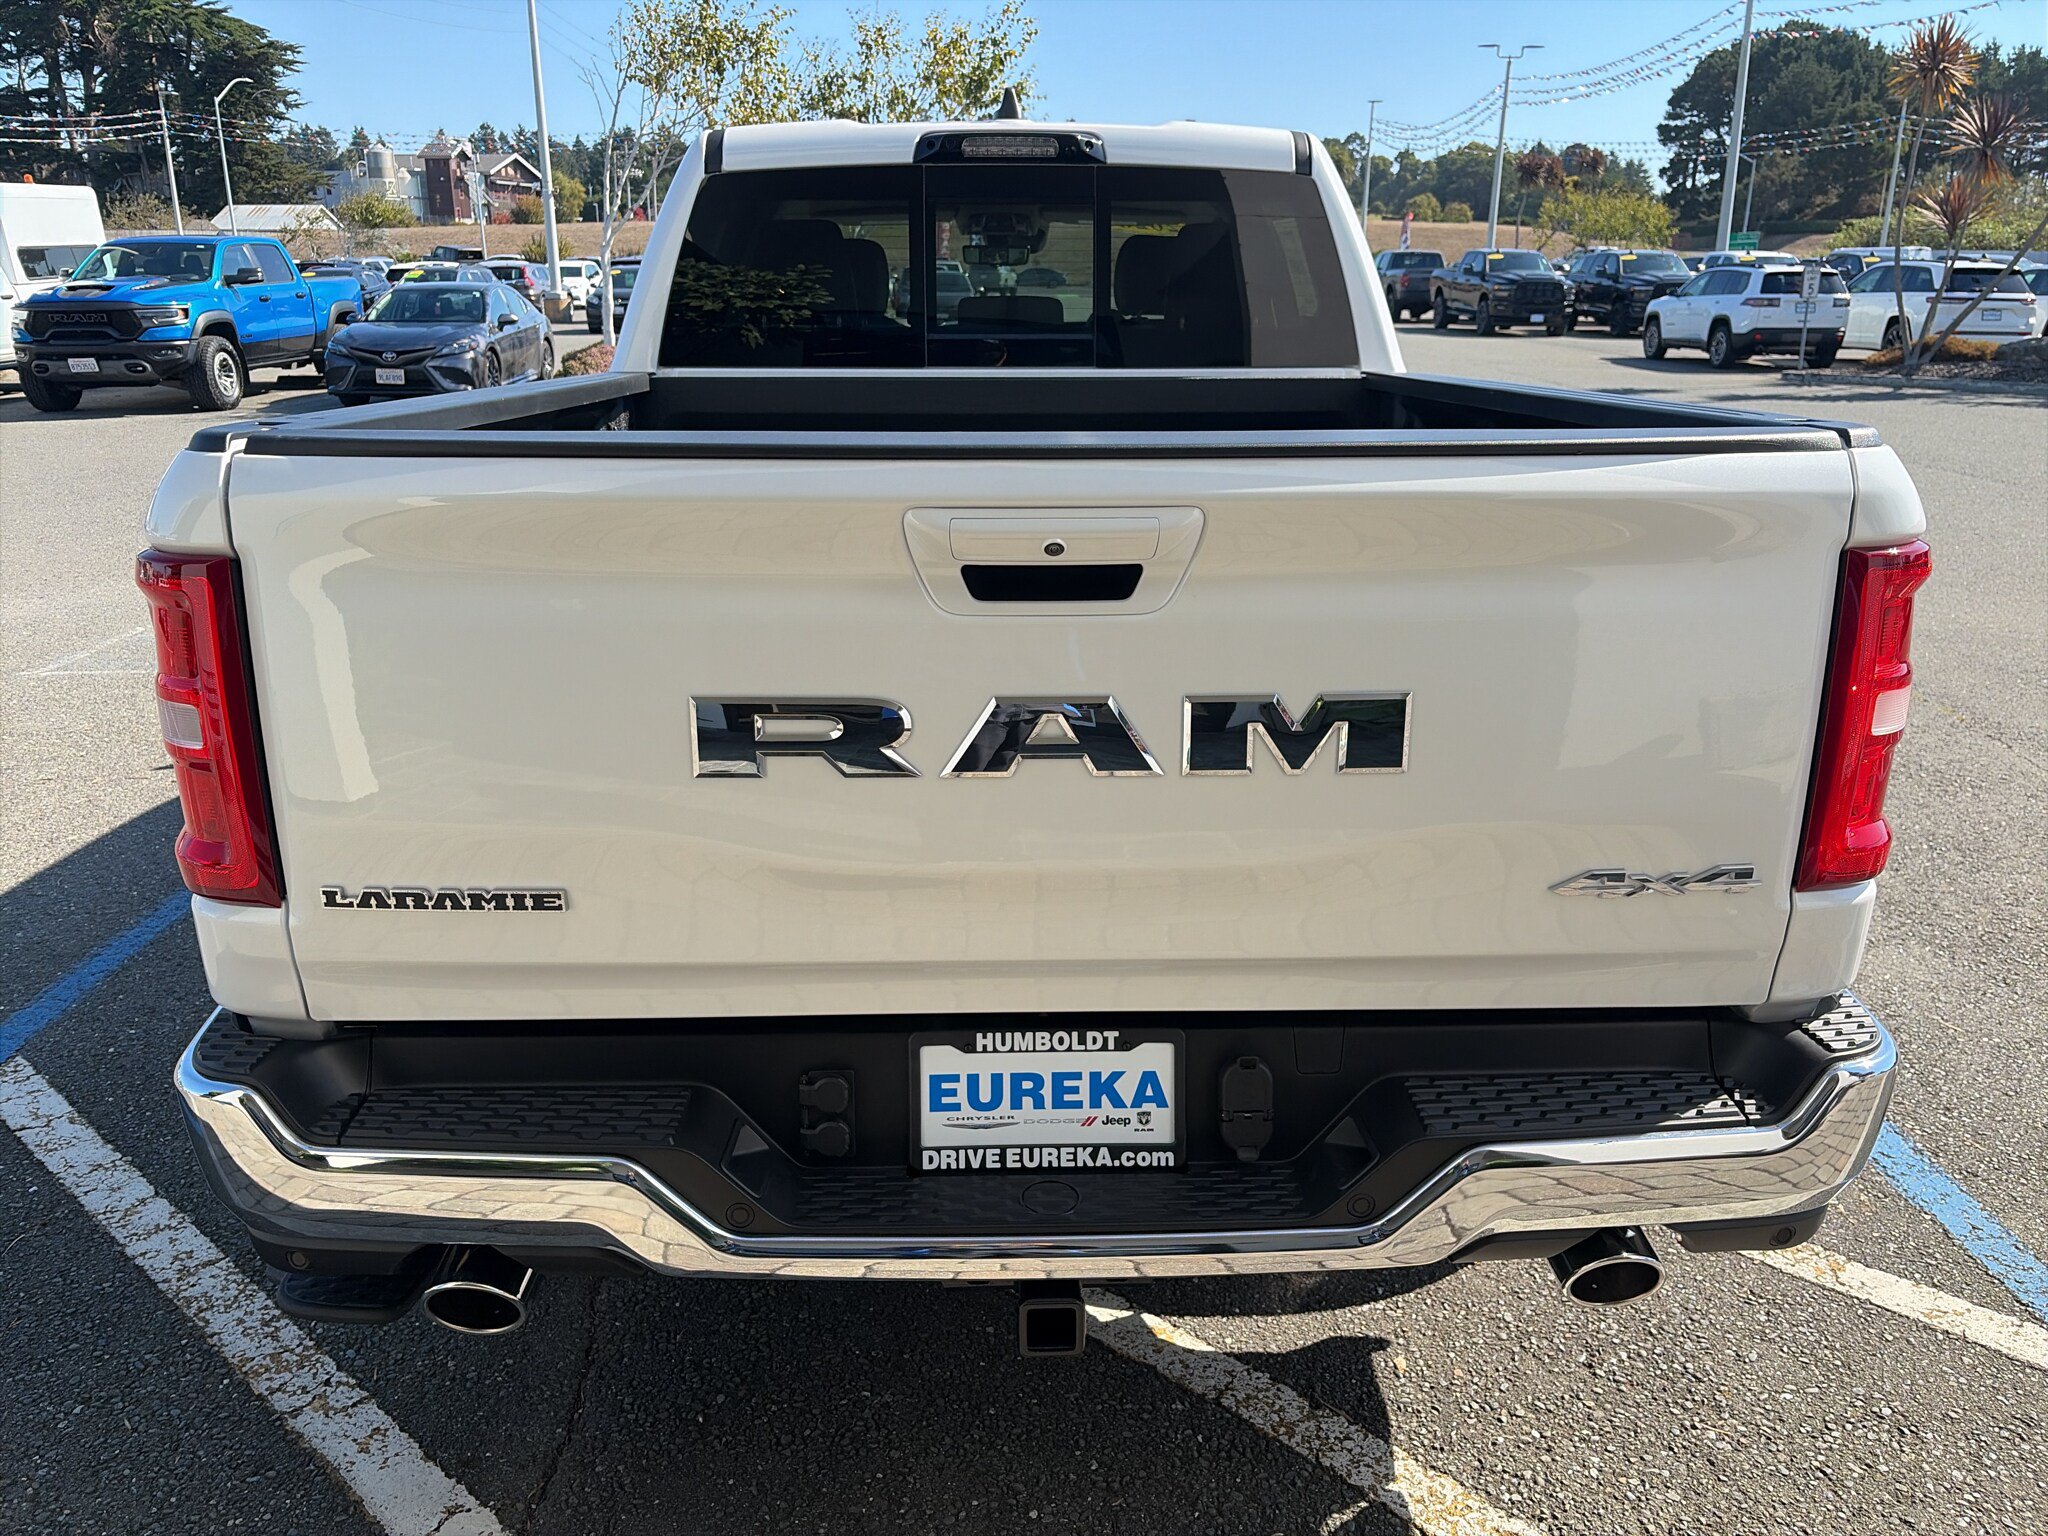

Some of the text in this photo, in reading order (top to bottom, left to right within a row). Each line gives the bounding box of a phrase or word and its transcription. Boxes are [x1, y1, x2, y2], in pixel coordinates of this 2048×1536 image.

[1808, 283, 1814, 295] 5
[48, 313, 108, 323] RAM
[689, 692, 1414, 779] RAM
[320, 885, 569, 912] LARAMIE
[976, 1031, 1120, 1052] HUMBOLDT
[929, 1070, 1169, 1112] EUREKA
[1101, 1115, 1131, 1127] Jeep
[922, 1147, 1175, 1170] DRIVE EUREKA.com
